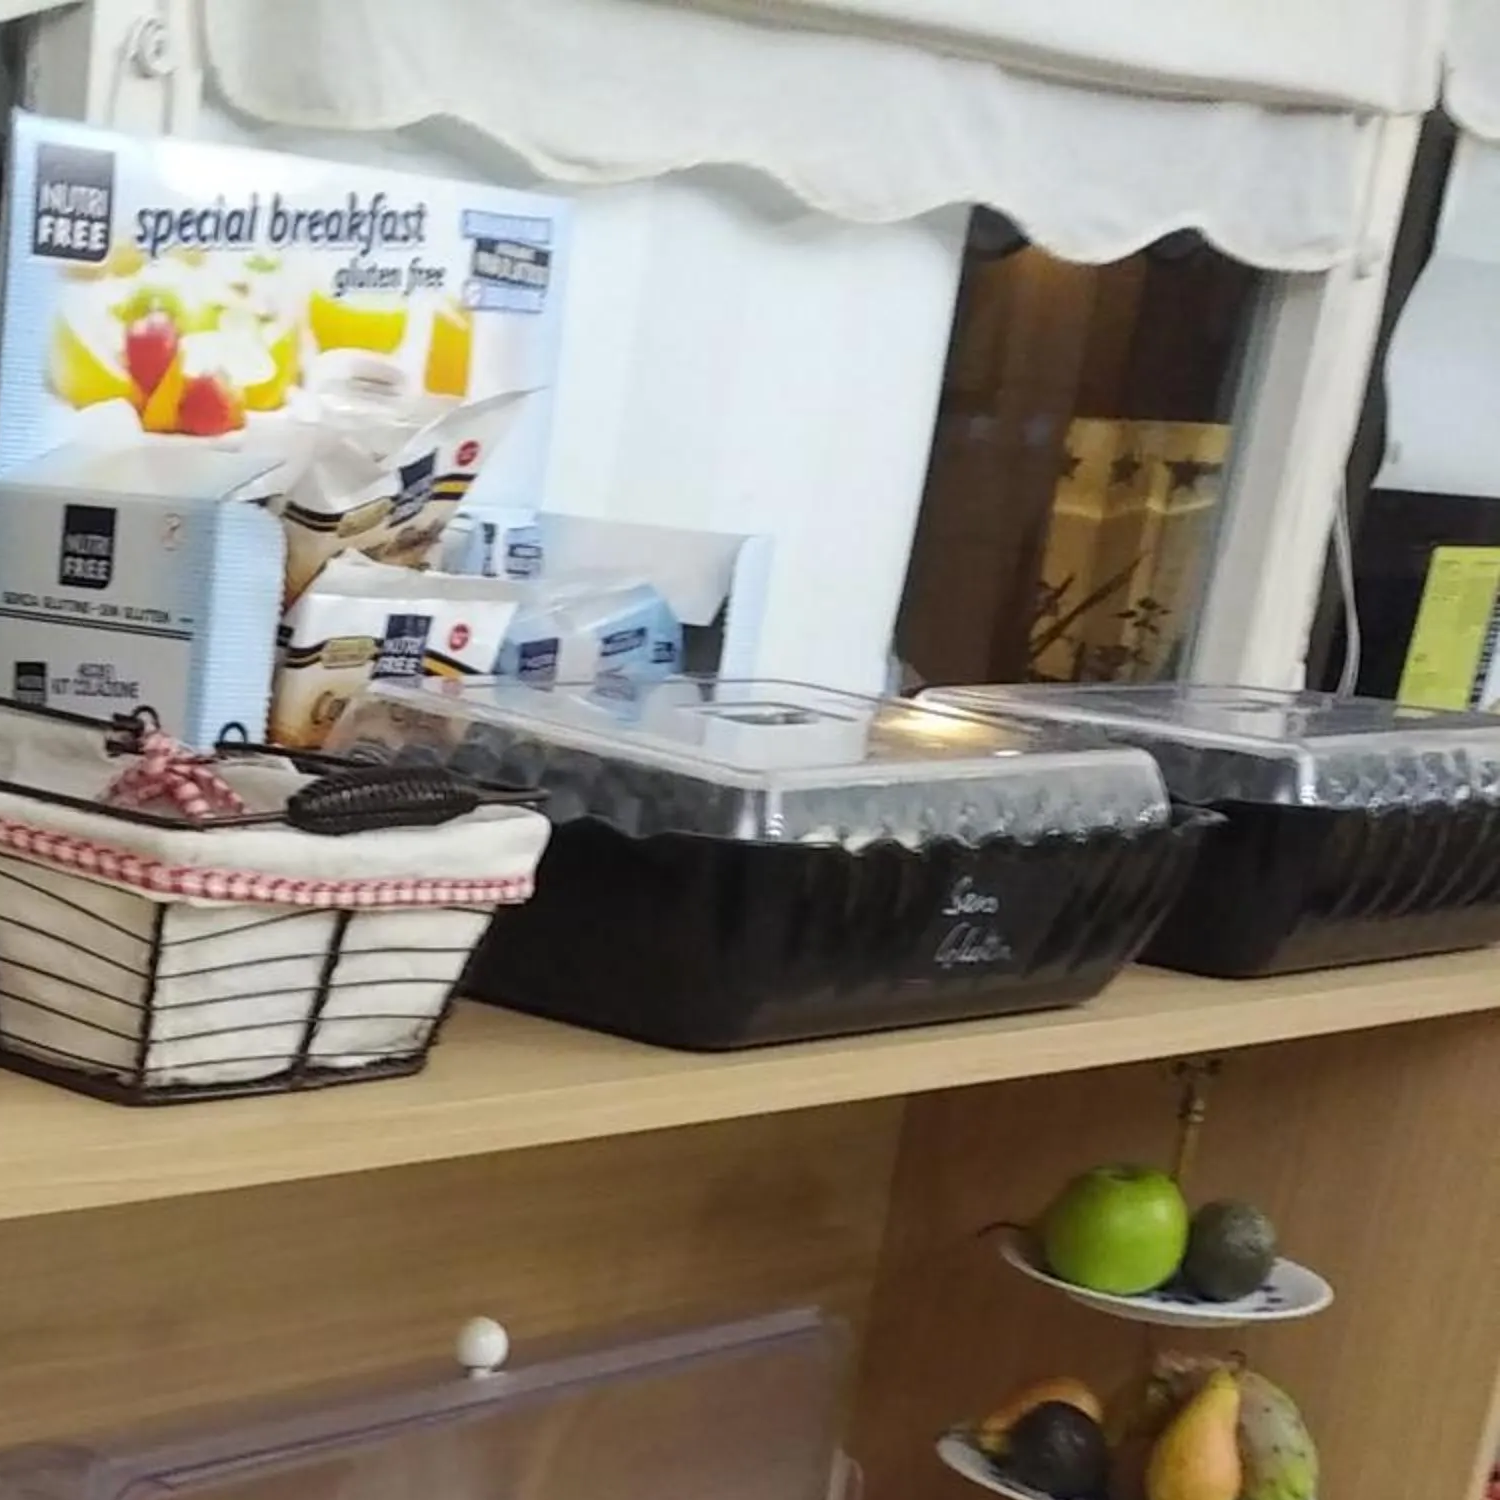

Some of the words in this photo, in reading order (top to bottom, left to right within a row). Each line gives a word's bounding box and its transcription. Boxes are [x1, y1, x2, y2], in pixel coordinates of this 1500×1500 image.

[37, 215, 108, 252] FREE
[136, 190, 259, 259] special
[269, 190, 428, 257] breakfast
[333, 257, 402, 297] gluten
[402, 257, 447, 297] free
[62, 556, 110, 581] FREE
[374, 655, 421, 675] FREE
